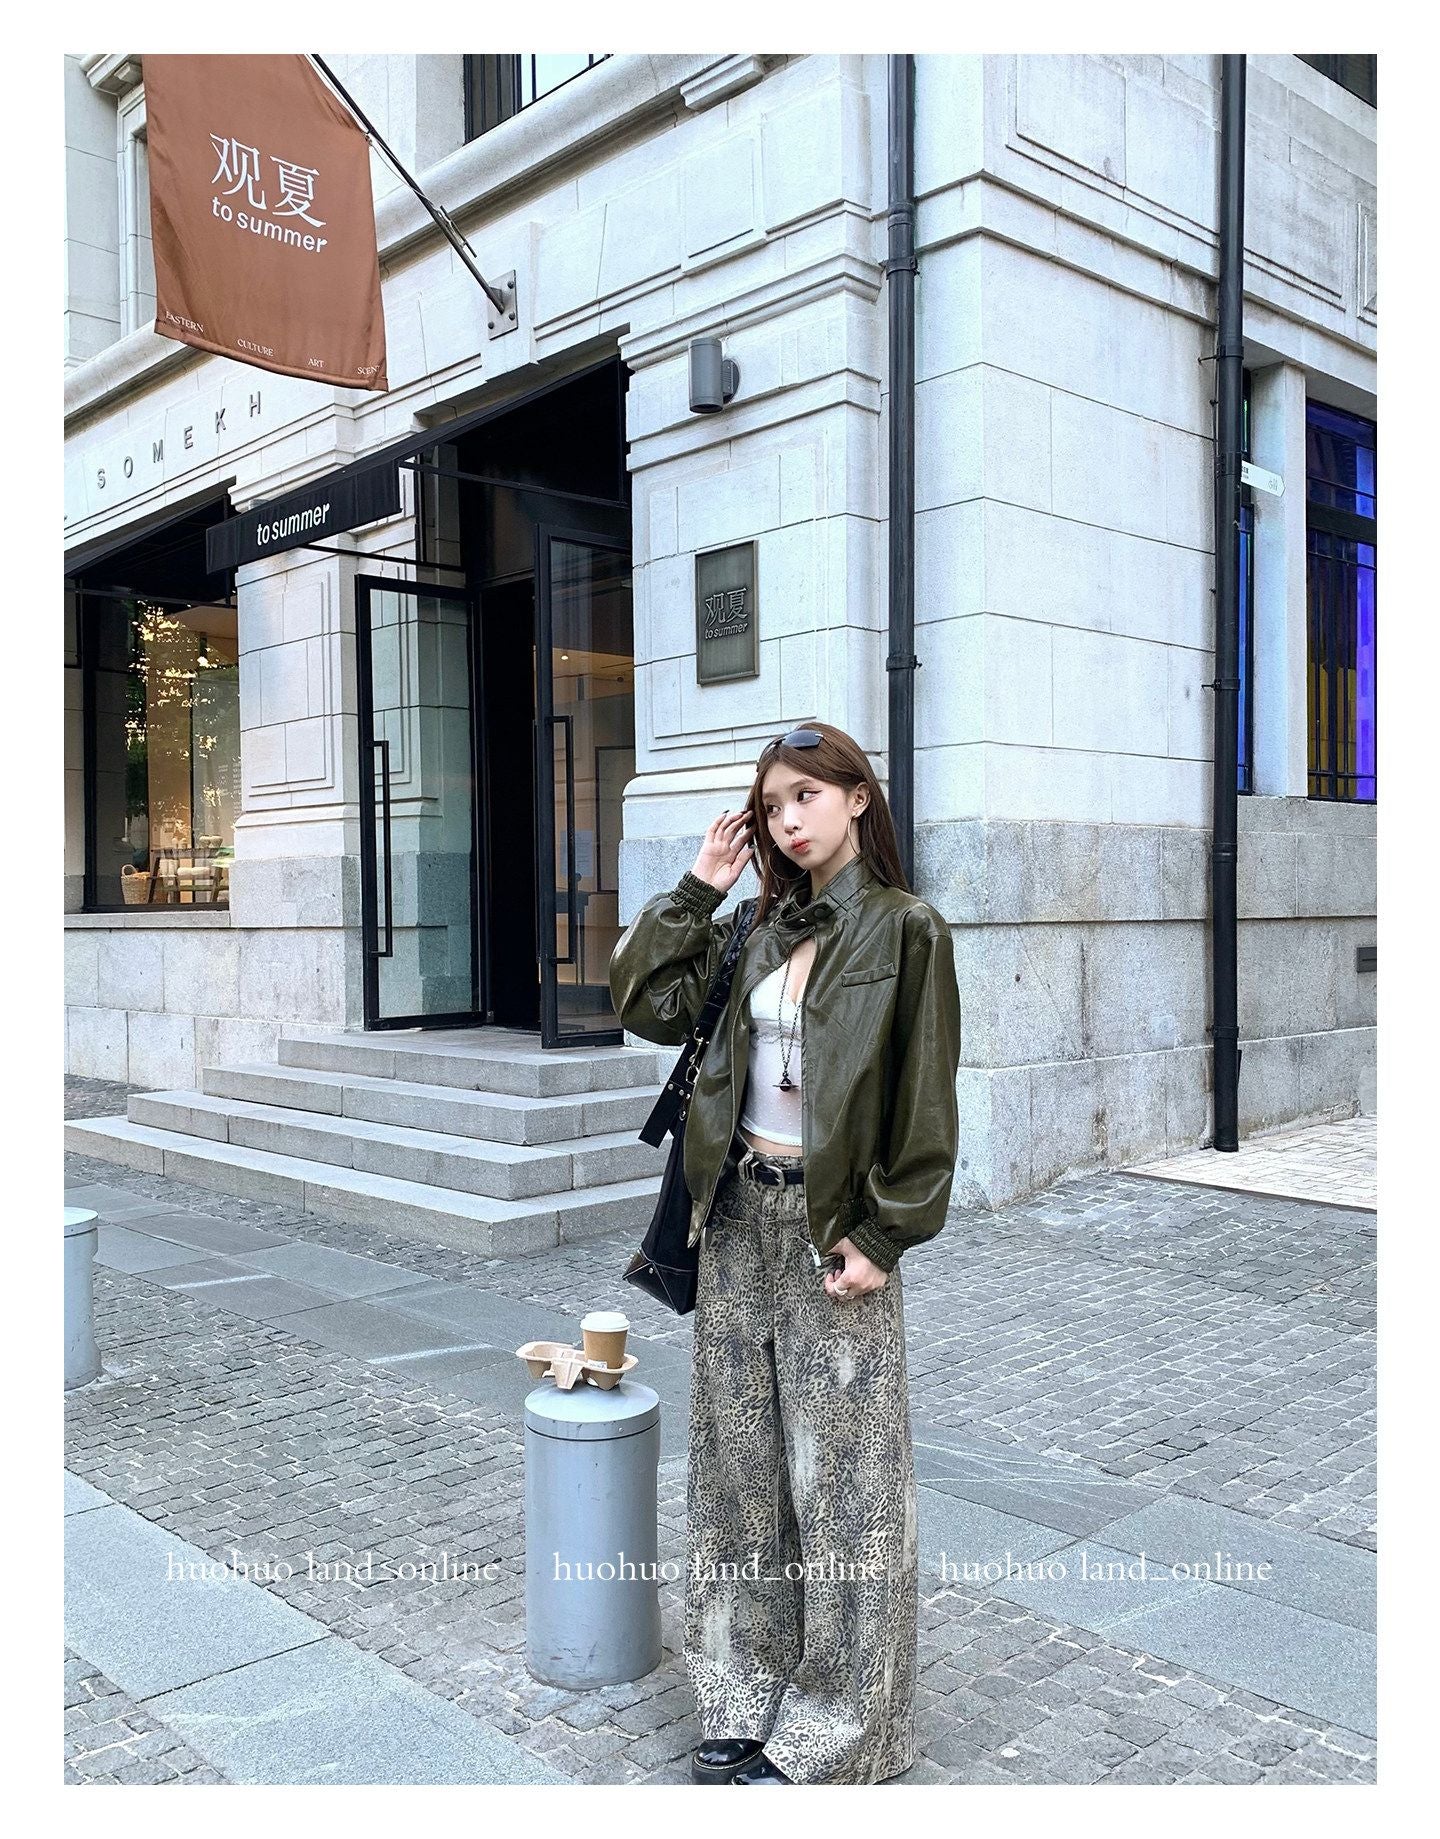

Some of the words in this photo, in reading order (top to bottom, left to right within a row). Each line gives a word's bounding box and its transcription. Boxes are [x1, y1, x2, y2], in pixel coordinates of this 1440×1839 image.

[209, 132, 327, 228] 观夏
[212, 196, 233, 222] to
[236, 211, 328, 253] summer
[165, 310, 204, 333] EASTERN
[237, 338, 274, 357] CULTURE
[308, 357, 325, 368] ART
[256, 523, 270, 546] to
[271, 503, 330, 541] summer
[705, 587, 748, 627] 观夏
[705, 628, 714, 639] to
[714, 623, 748, 638] summer
